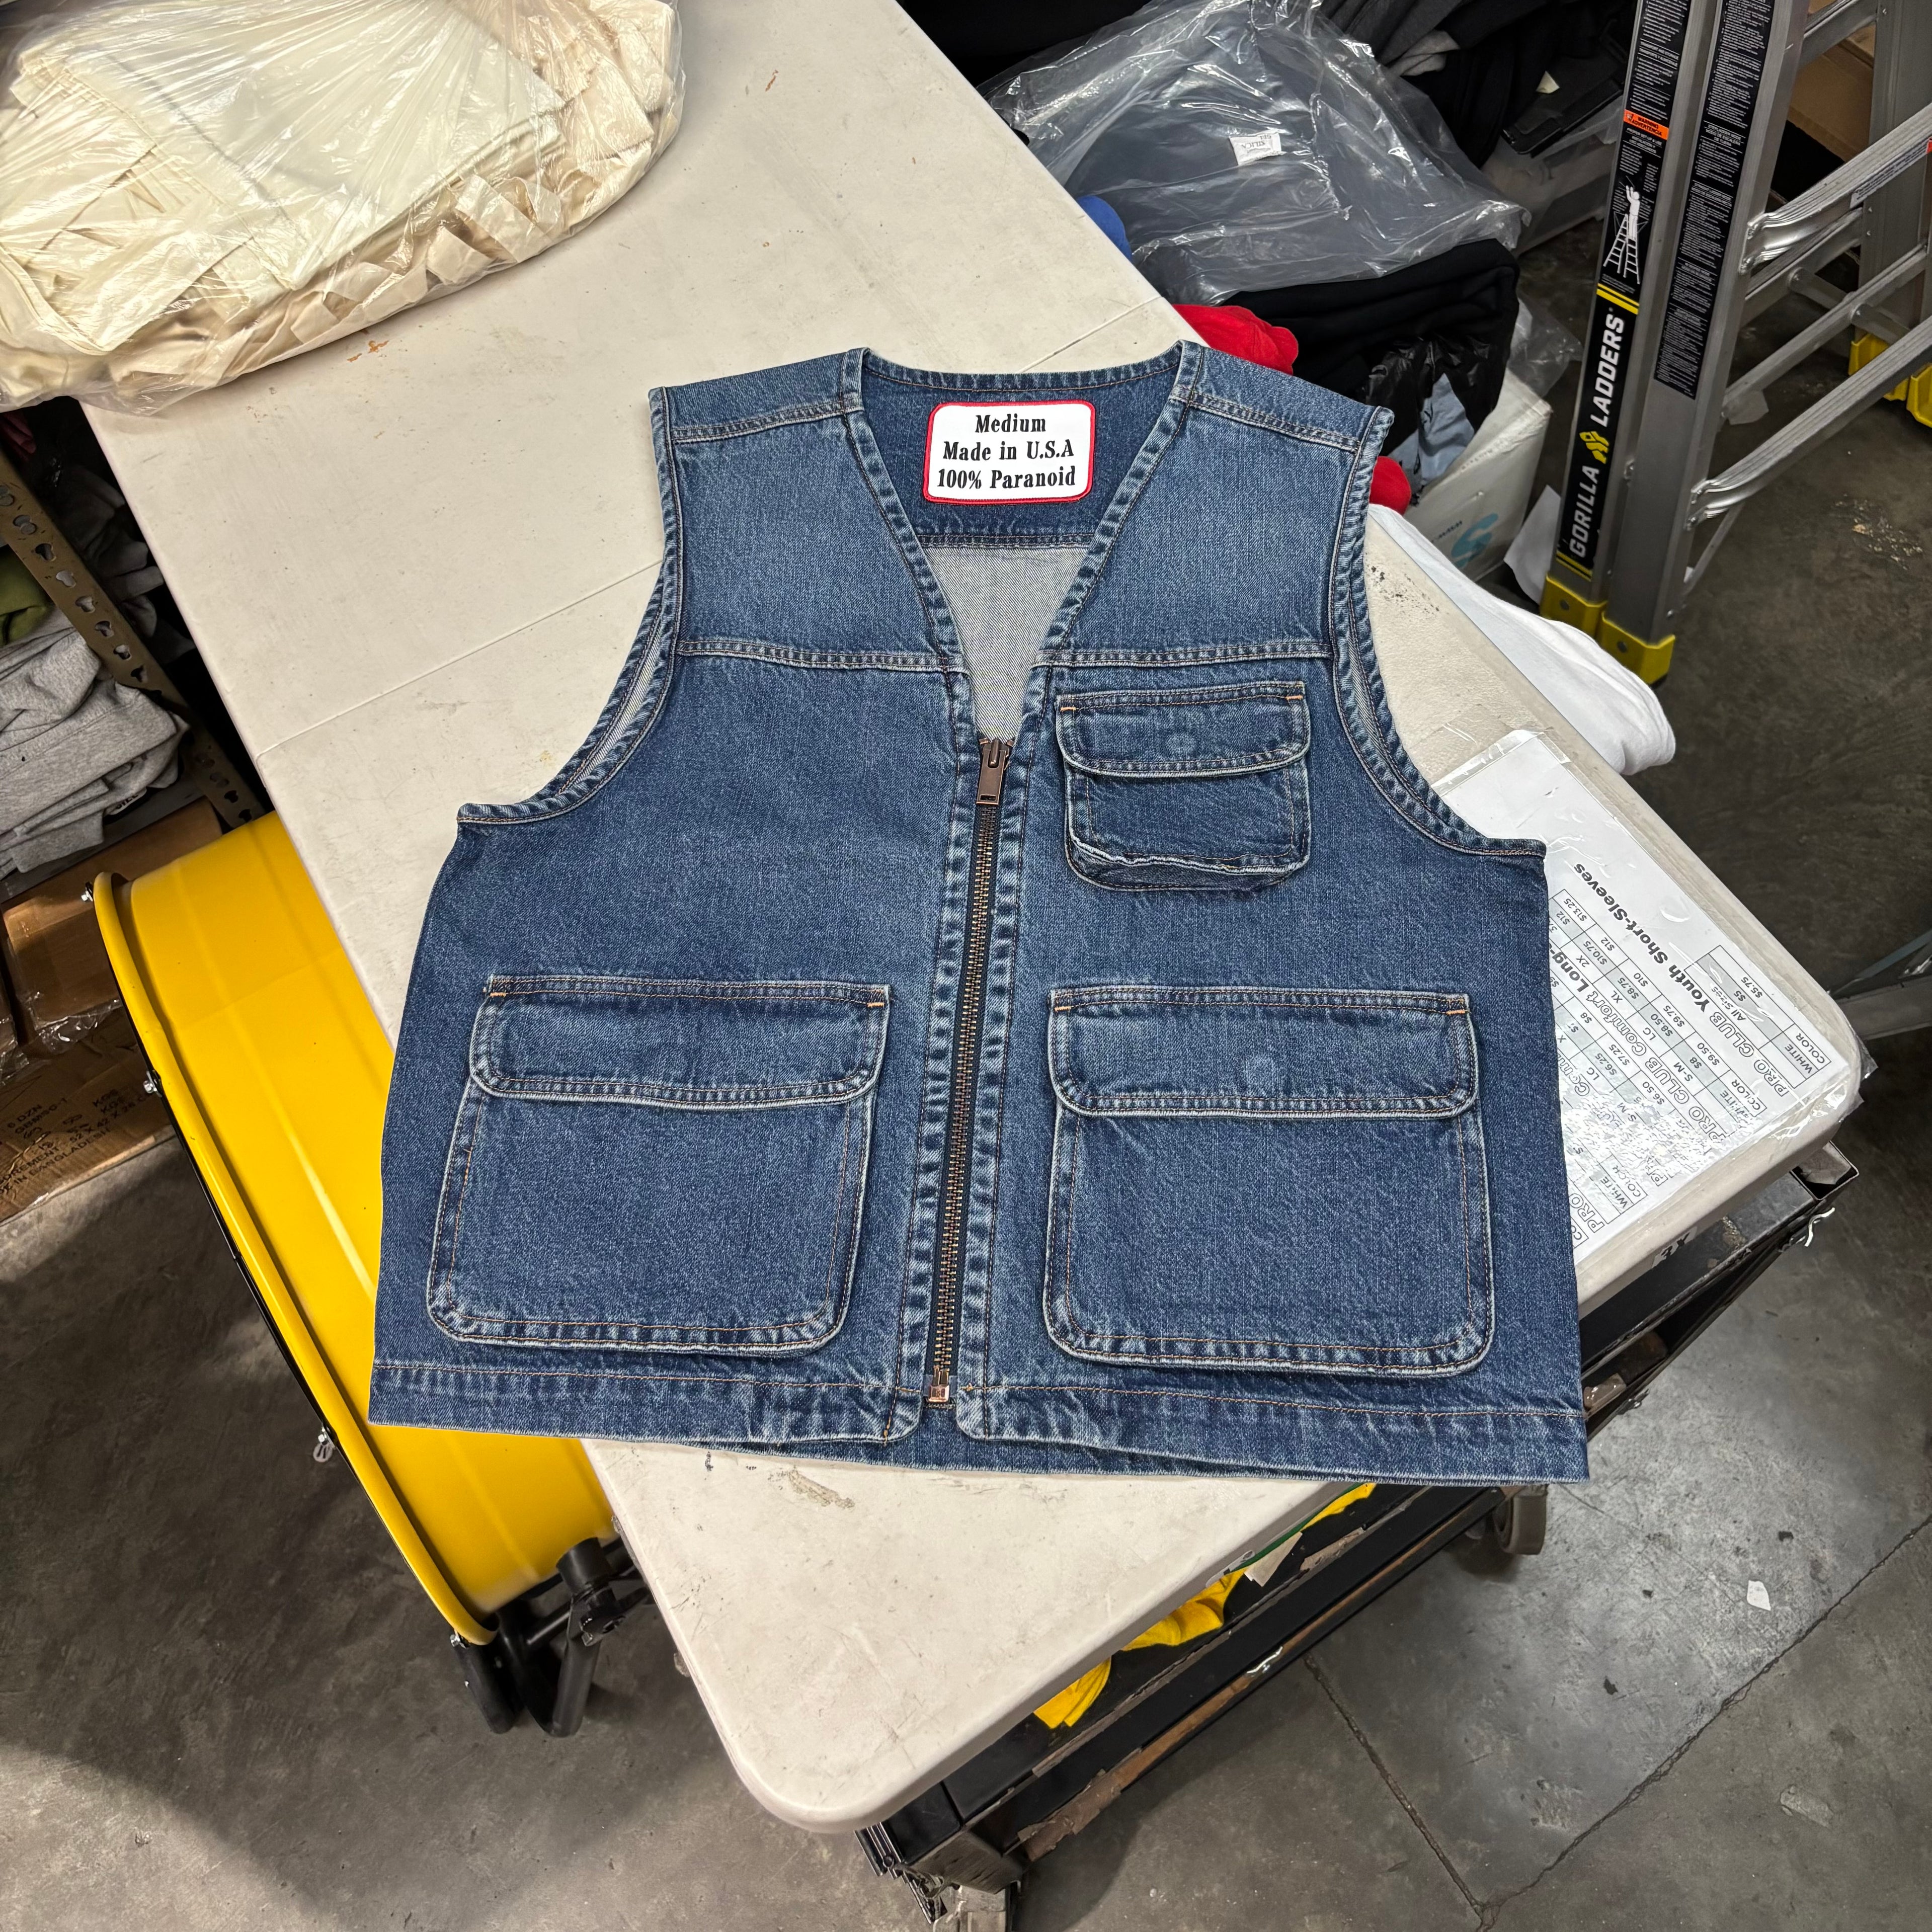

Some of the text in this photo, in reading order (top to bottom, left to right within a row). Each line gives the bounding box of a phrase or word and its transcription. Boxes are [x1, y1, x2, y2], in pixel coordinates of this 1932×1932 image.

[1242, 140, 1265, 149] SILICA
[975, 413, 1046, 434] Medium
[1569, 465, 1599, 558] GORILLA
[1590, 315, 1625, 428] LADDERS
[943, 439, 1074, 461] Made in U.S.A
[937, 465, 1075, 490] 100% Paranoid
[1556, 910, 1570, 925] $12
[1575, 954, 1590, 968] 2X
[1582, 940, 1607, 965] $10.75
[1549, 942, 1589, 992] Long-
[1573, 863, 1792, 1097] PRO CLUB Youth Short-Sleeves
[1617, 977, 1639, 999] $8.75
[1563, 898, 1760, 1110] COLOR $9.50 $9.75 $10 $12 $13.25
[1611, 990, 1623, 1004] XL
[1580, 1012, 1592, 1023] $8
[1585, 990, 1647, 1056] Comfort
[1650, 1013, 1673, 1036] $8.50
[1730, 1009, 1746, 1021] All
[1740, 977, 1825, 1064] COLOR $5.75
[1642, 1027, 1656, 1040] LG
[1733, 990, 1812, 1074] WHITE $5
[1594, 1052, 1617, 1075] $6.25
[1608, 1043, 1630, 1066] $7.25
[1689, 1057, 1702, 1069] $8
[1558, 1054, 1591, 1096] Com
[1586, 1067, 1599, 1081] LG
[1644, 1057, 1689, 1104] CLUB
[1673, 1061, 1693, 1082] S-M
[1642, 1081, 1665, 1105] $6.50
[1685, 1103, 1726, 1145] PRO
[1569, 1193, 1605, 1234] PRO
